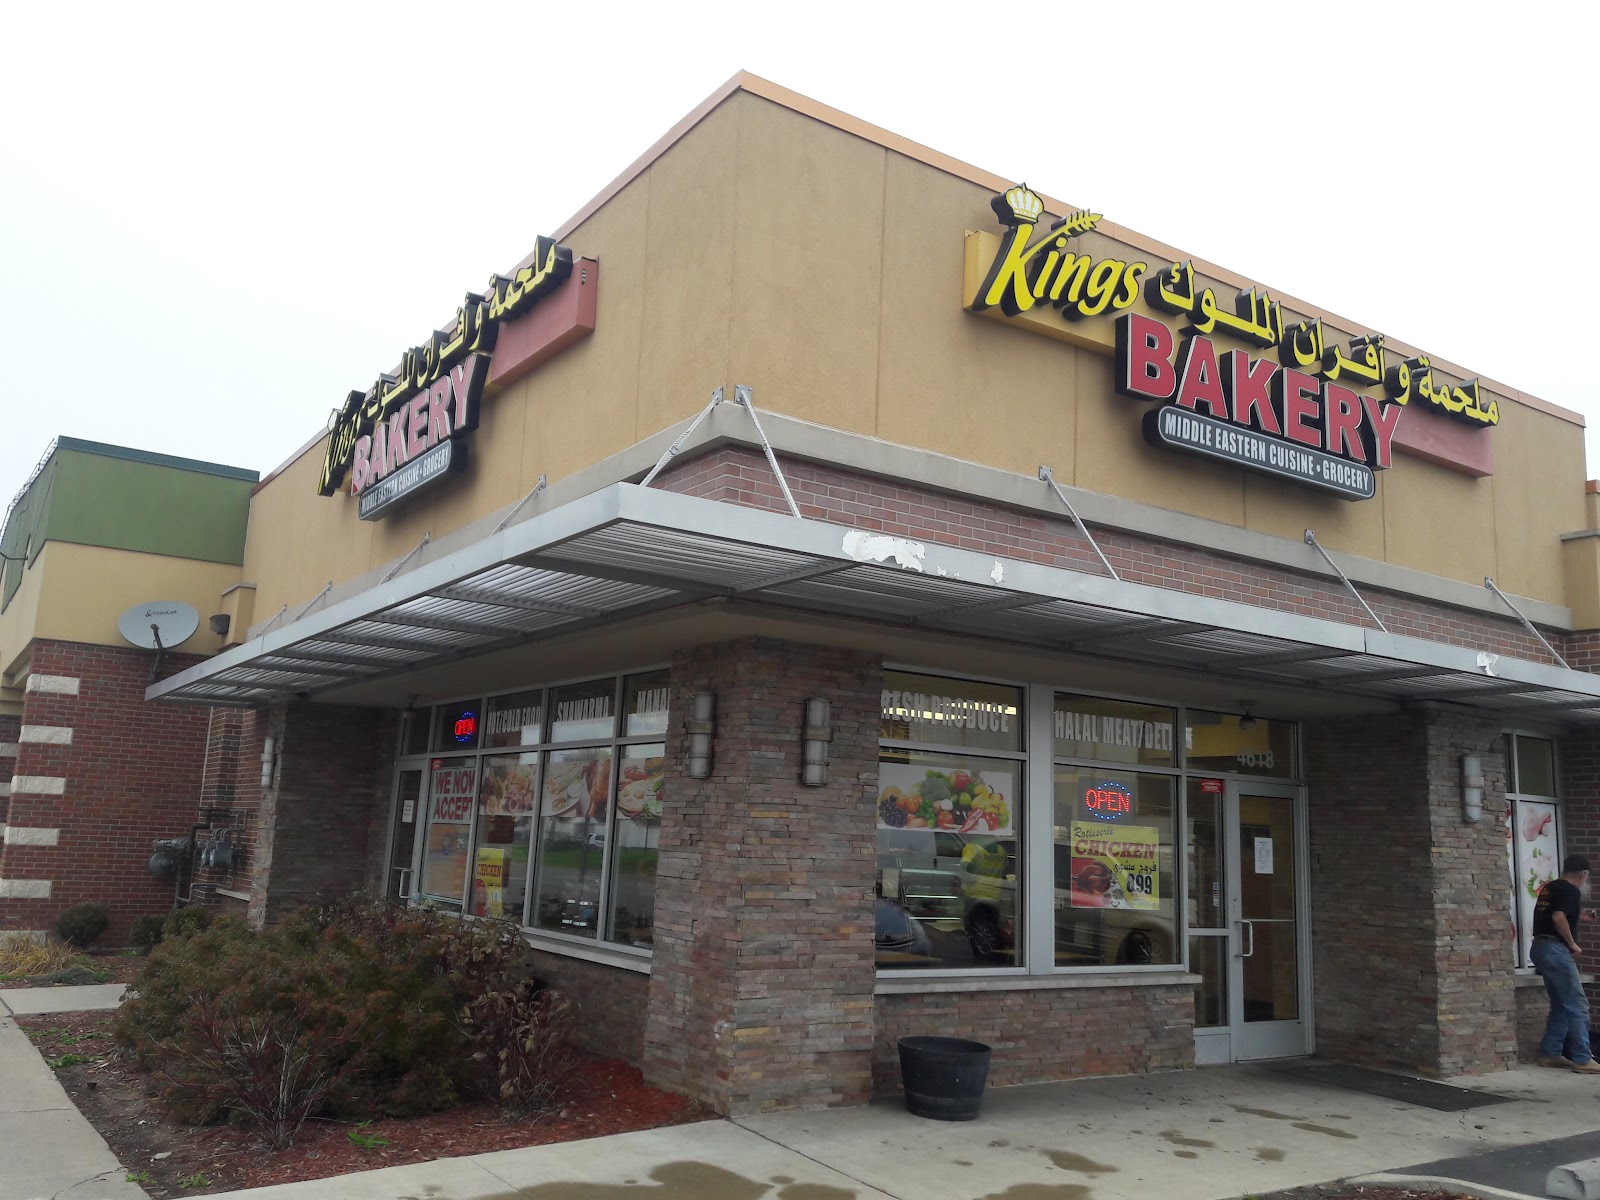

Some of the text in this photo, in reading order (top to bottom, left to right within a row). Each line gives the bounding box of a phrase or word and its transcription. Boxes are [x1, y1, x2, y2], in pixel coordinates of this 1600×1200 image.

[983, 222, 1148, 317] Kings
[1158, 259, 1283, 344] الملوك
[1125, 310, 1404, 469] BAKERY
[1417, 355, 1501, 427] ملحمة
[350, 352, 478, 497] BAKERY
[423, 446, 449, 478] GROCERY
[1164, 412, 1370, 492] MIDDLE EASTERN CUISINE GROCERY
[556, 696, 610, 722] SHAWARMA
[637, 687, 671, 715] MANA
[880, 688, 1009, 733] RESH PRODUCE
[453, 717, 475, 736] OPEN
[486, 708, 520, 735] HOT/COLD
[1055, 709, 1098, 743] HALAL
[435, 771, 452, 795] WE
[1086, 788, 1131, 814] OPEN
[1073, 826, 1115, 839] Rotisserie
[1073, 839, 1157, 860] CHICKEN
